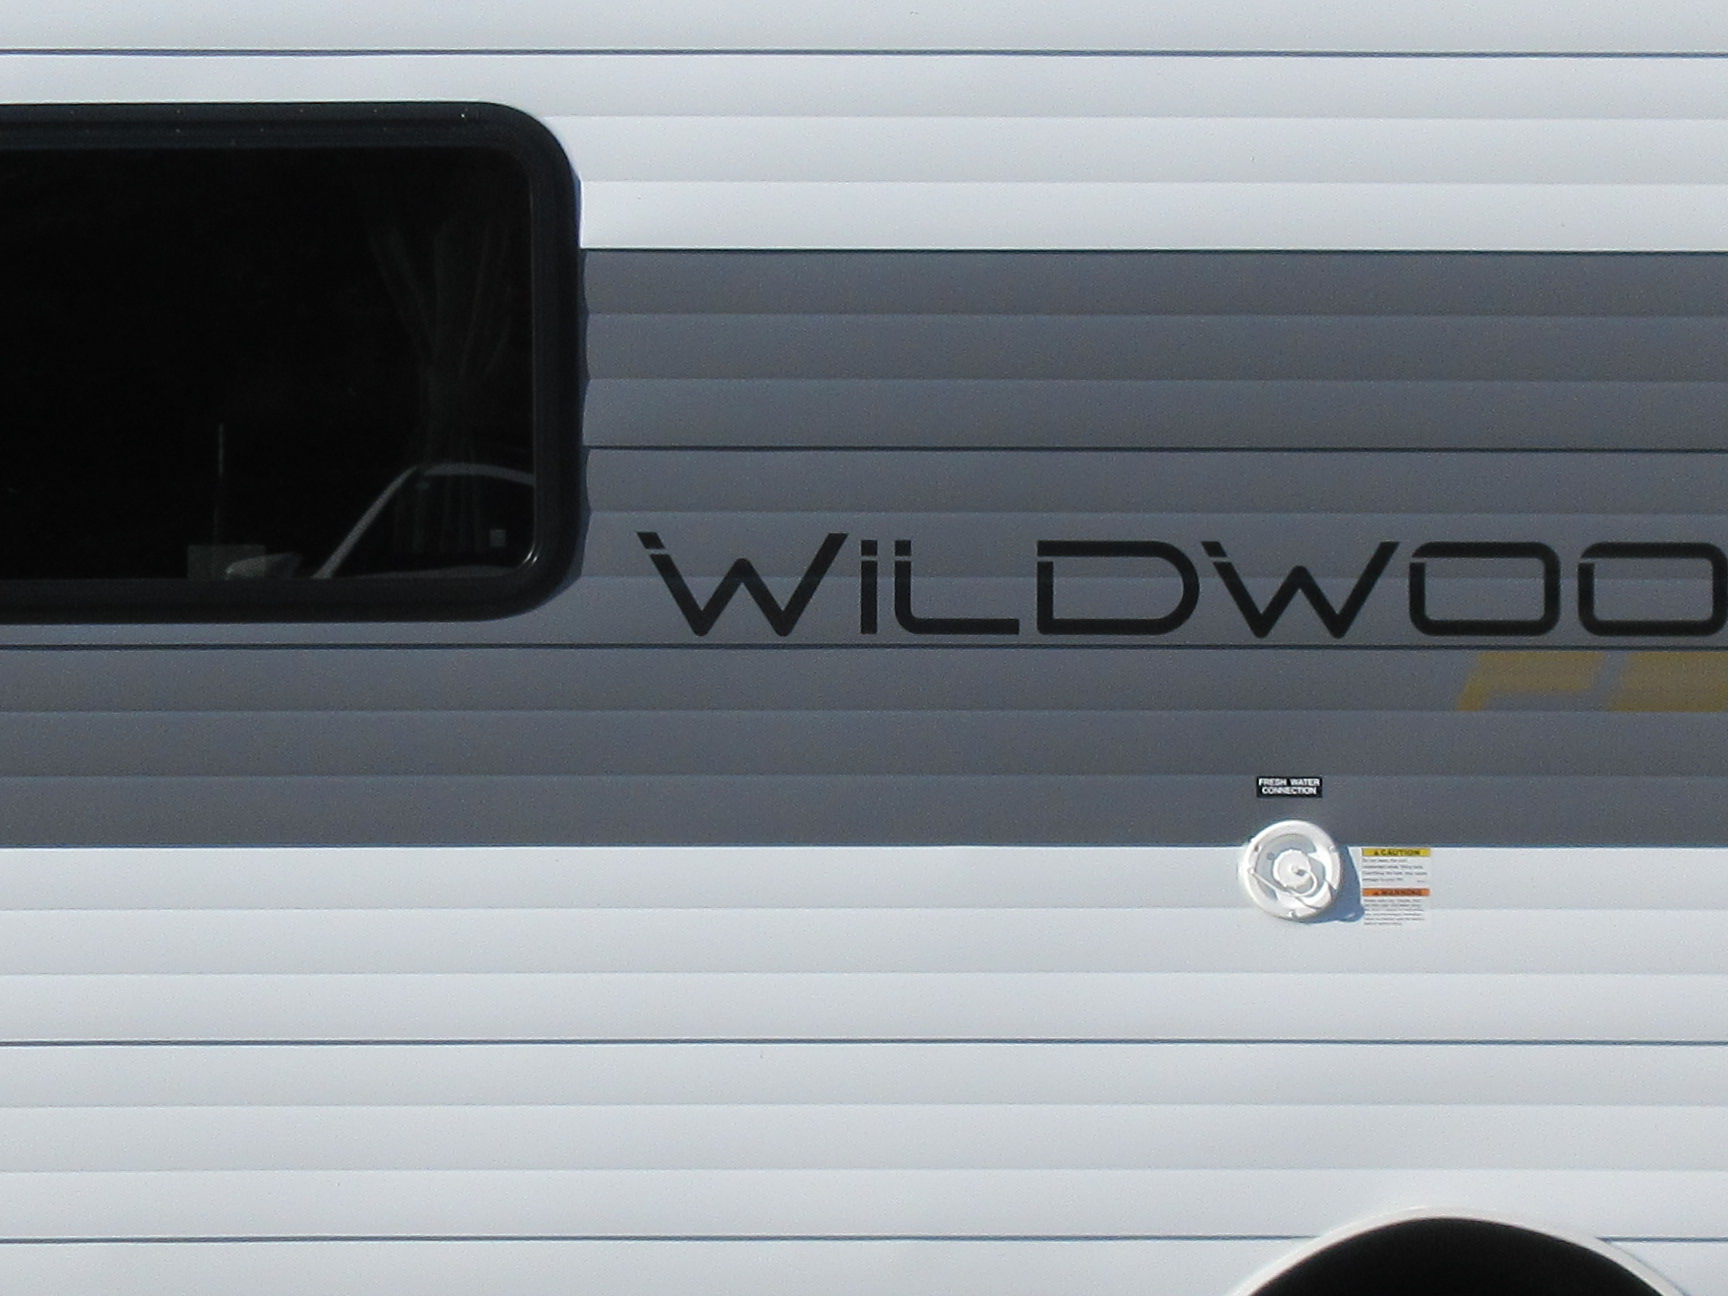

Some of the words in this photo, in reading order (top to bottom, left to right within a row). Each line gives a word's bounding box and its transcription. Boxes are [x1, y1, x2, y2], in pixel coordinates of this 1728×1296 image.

[1258, 777, 1287, 786] FRESH
[1289, 777, 1320, 786] WATER
[1261, 786, 1317, 795] CONNECTION
[1380, 847, 1421, 856] CAUTION
